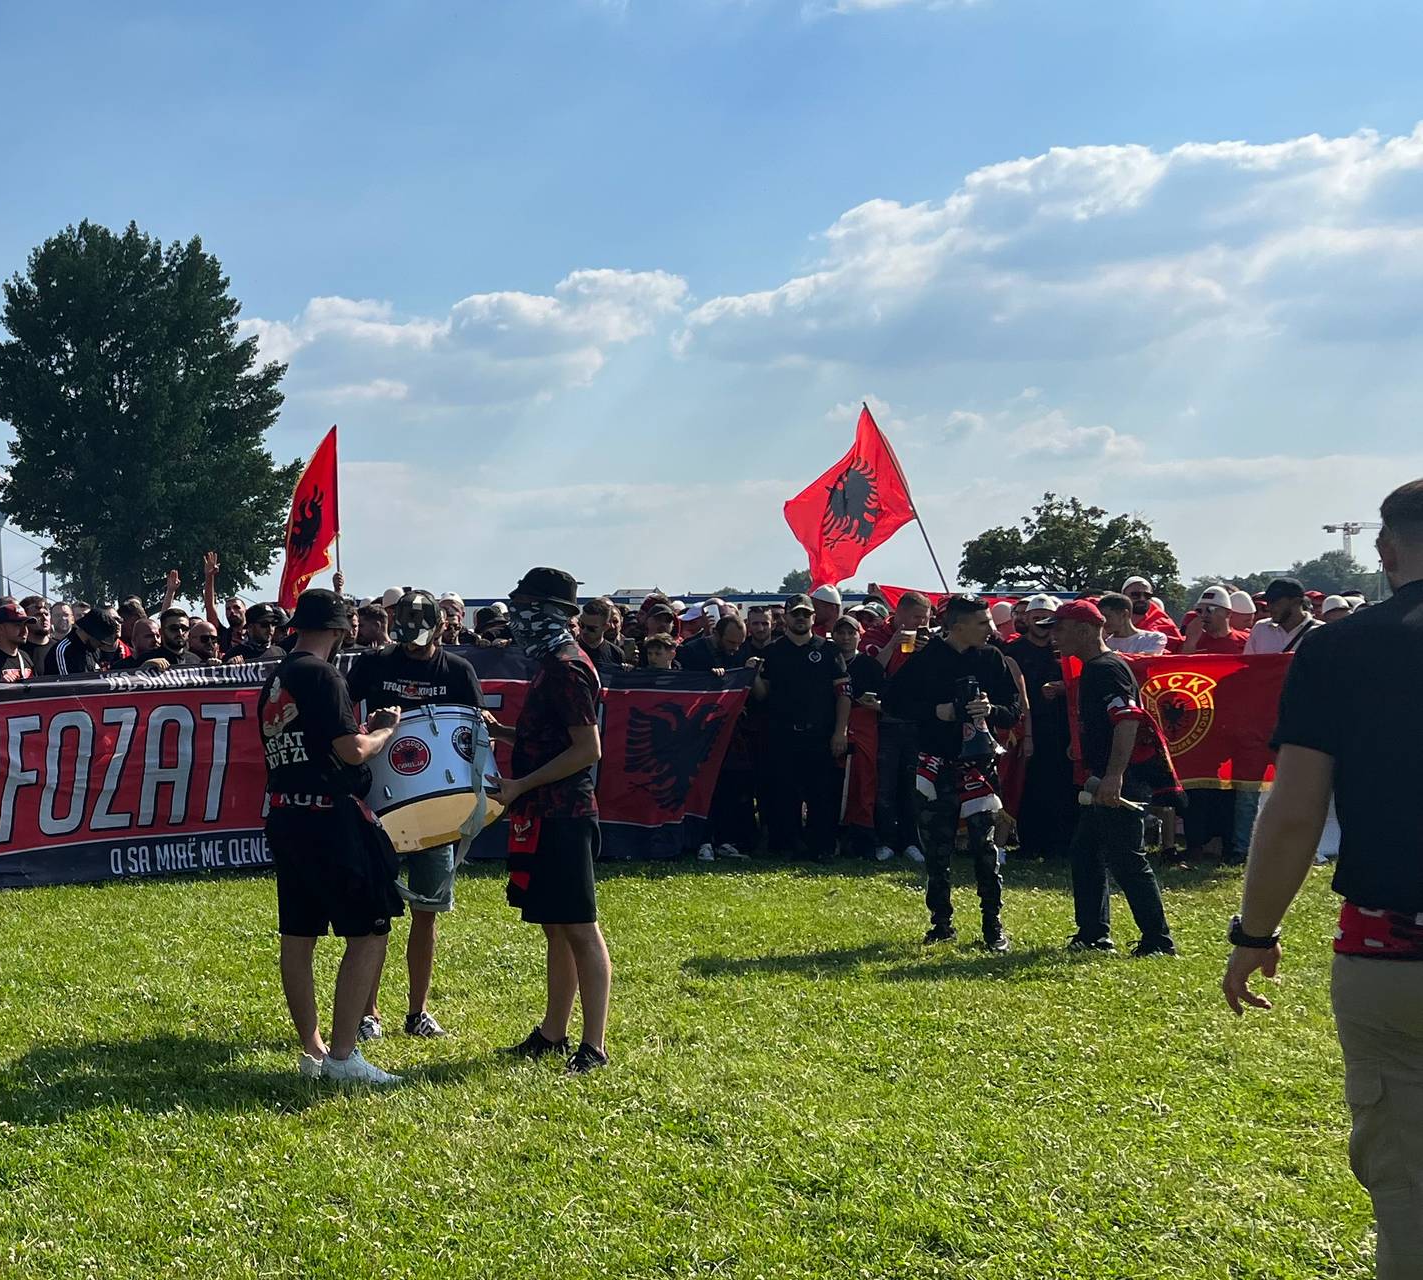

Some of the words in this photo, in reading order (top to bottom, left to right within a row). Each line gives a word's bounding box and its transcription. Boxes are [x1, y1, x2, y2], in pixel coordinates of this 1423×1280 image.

[127, 845, 151, 873] SA
[155, 837, 198, 871] MIRË
[201, 839, 225, 867] ME
